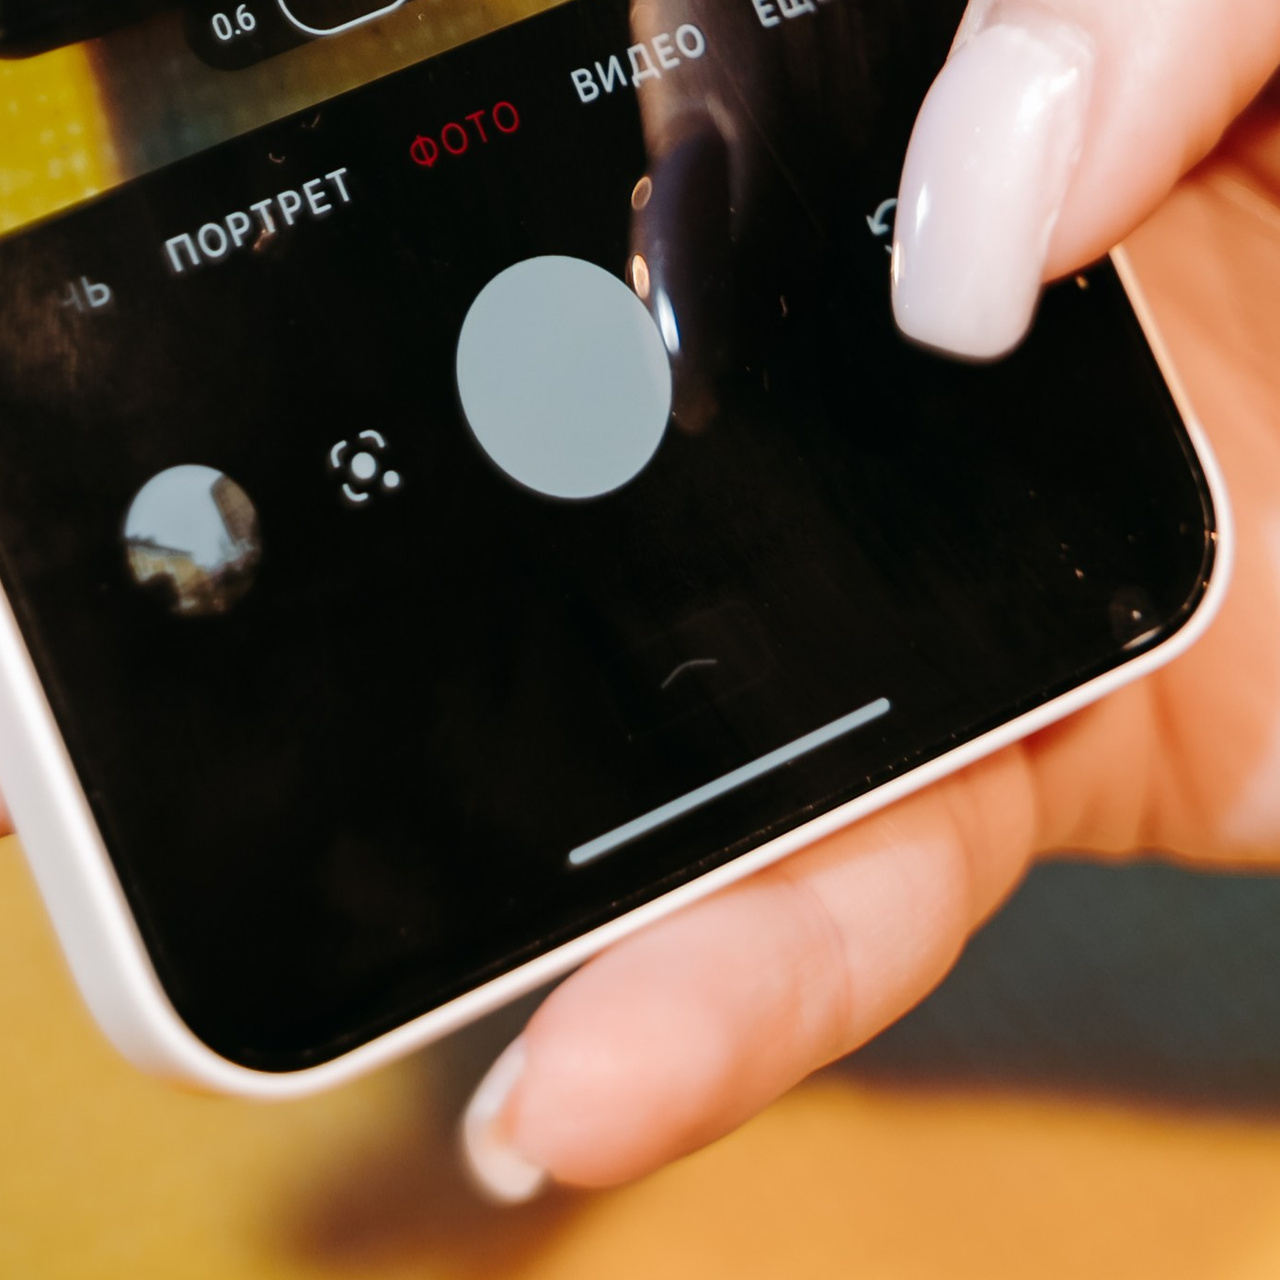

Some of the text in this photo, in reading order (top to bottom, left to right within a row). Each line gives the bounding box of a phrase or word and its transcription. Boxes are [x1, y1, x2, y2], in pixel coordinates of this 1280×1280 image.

[211, 3, 257, 42] 0.6
[164, 167, 350, 273] ПОРТРЕТ
[410, 101, 520, 168] ФОТО
[570, 23, 706, 104] ВИДЕО
